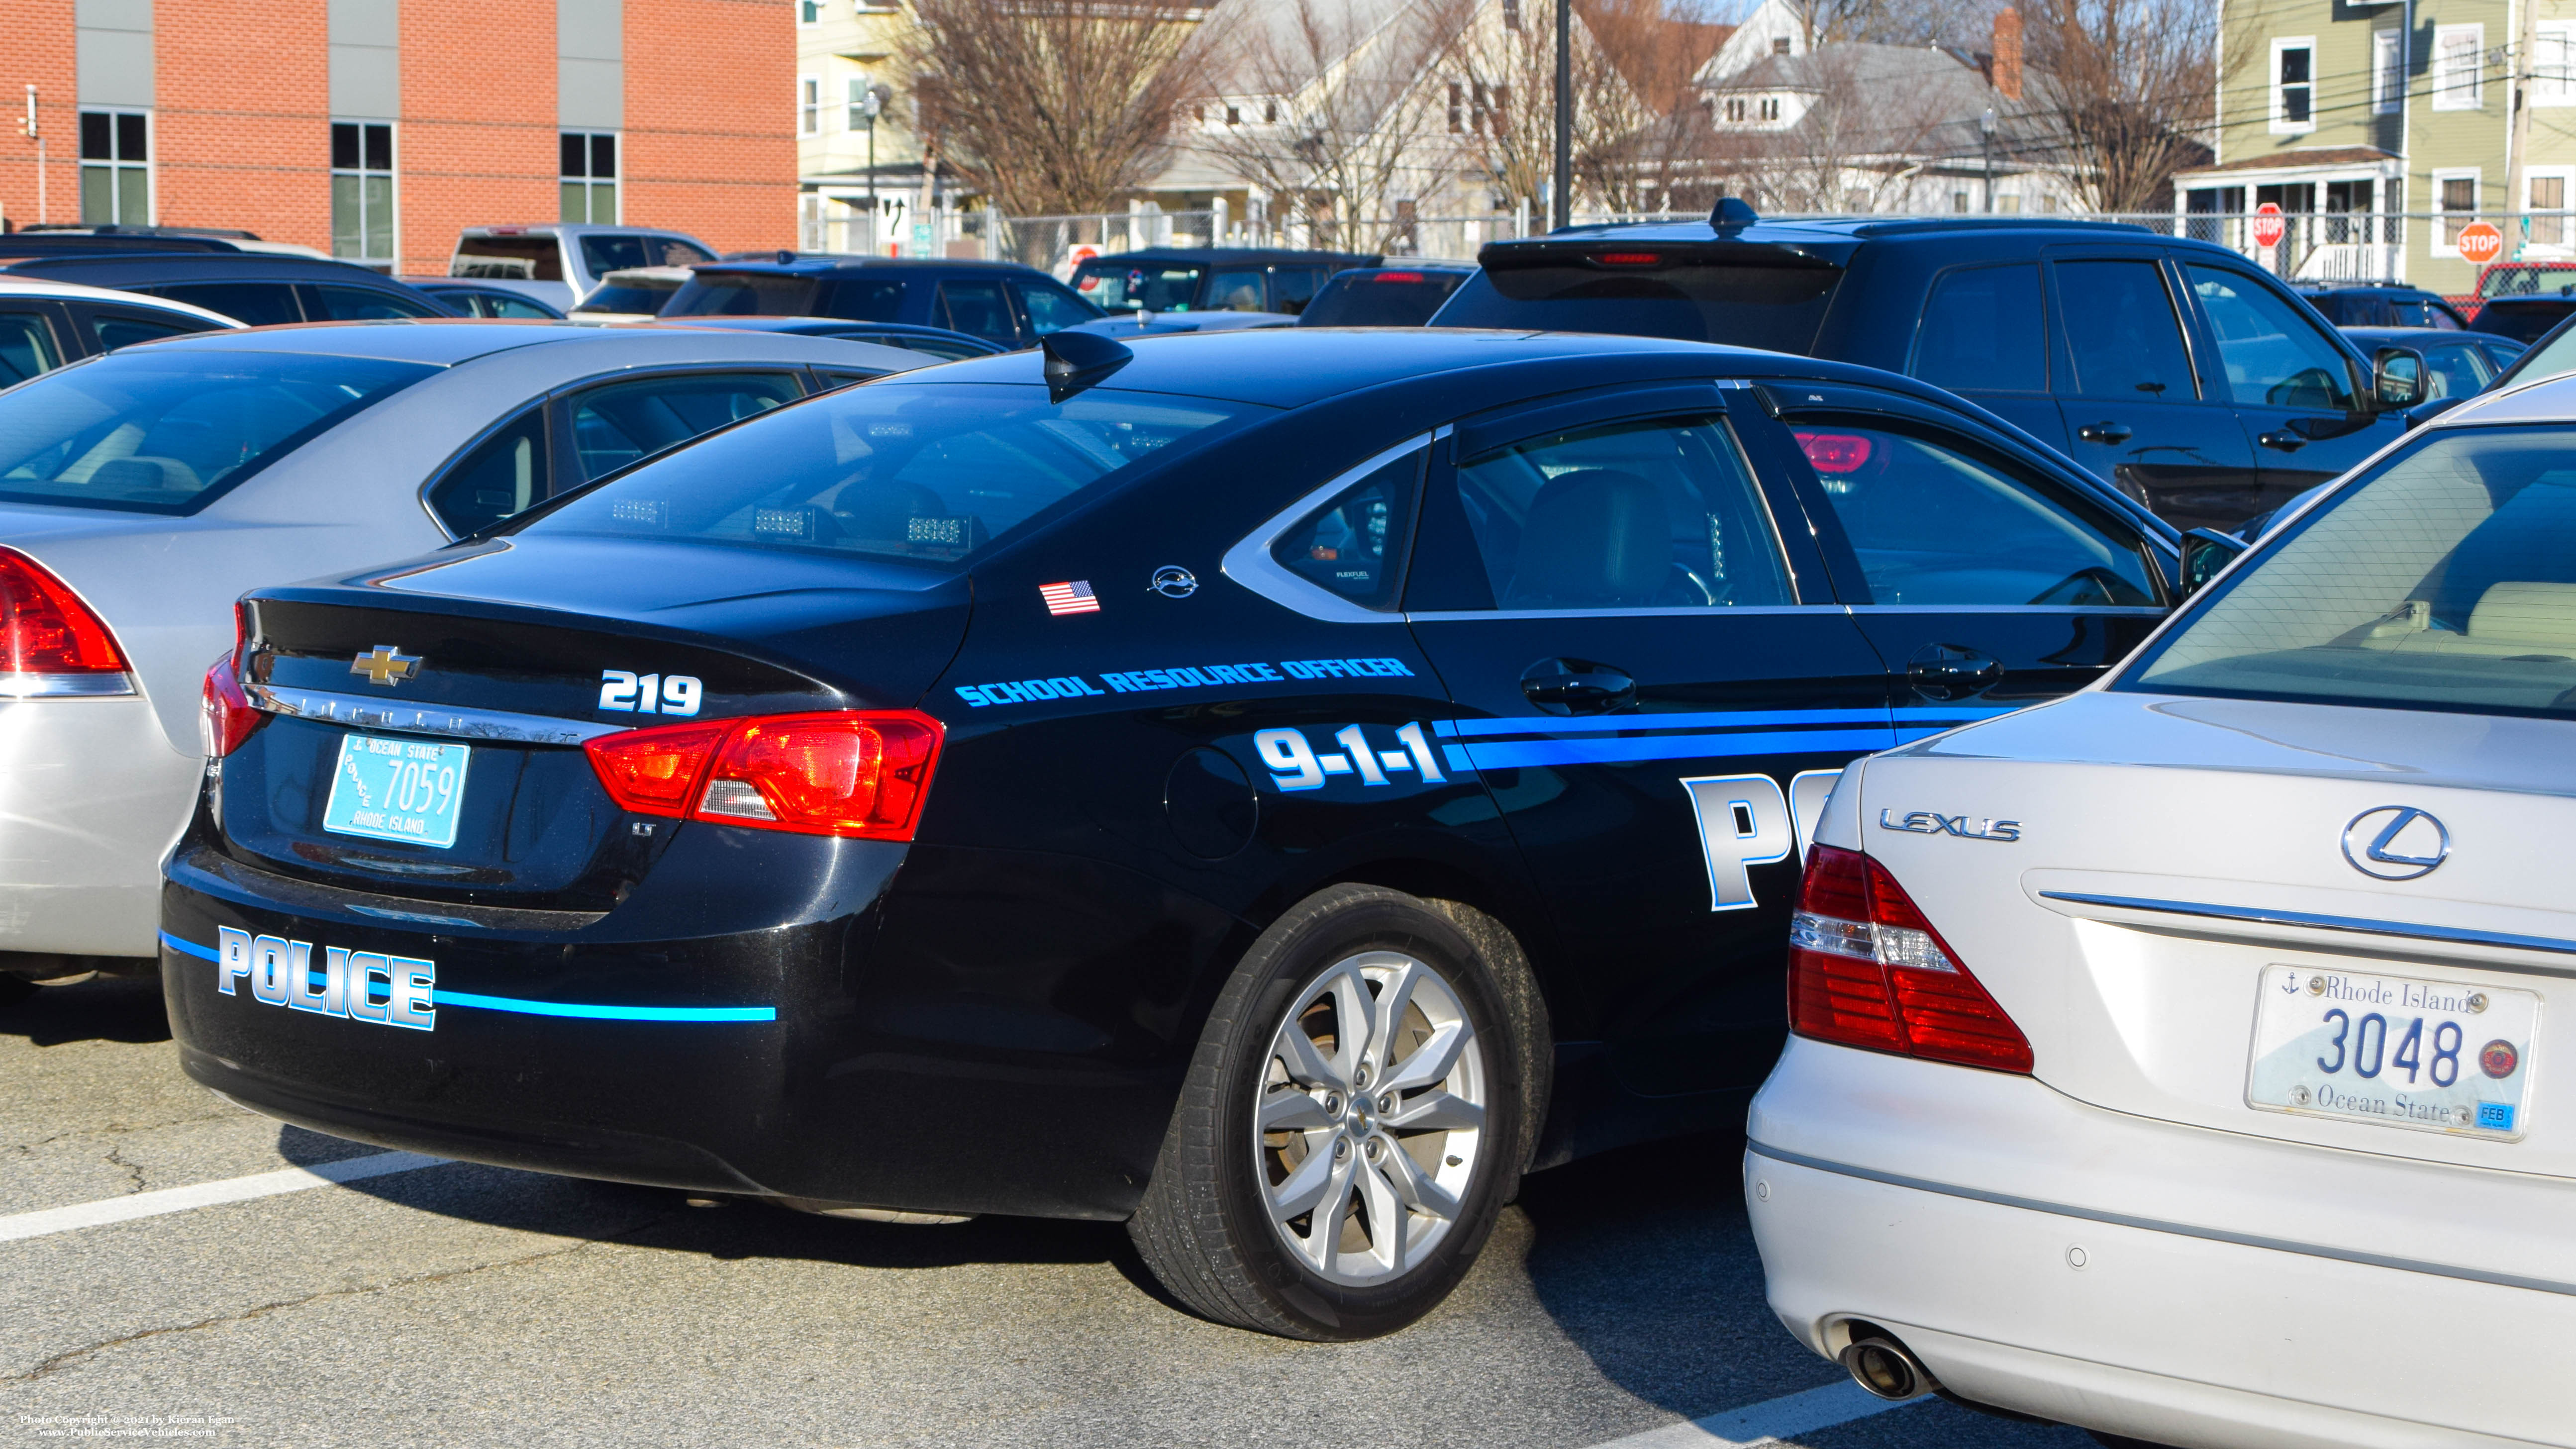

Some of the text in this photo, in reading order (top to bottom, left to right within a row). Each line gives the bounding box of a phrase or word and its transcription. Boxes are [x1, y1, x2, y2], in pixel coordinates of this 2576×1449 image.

[2254, 217, 2281, 236] STOP
[2461, 235, 2498, 252] STOP
[598, 669, 702, 716] 219
[955, 658, 1415, 707] SCHOOL RESOURCE OFFICER
[370, 739, 438, 762] OCEAN STATE
[1253, 721, 1447, 792] 9-1-1
[344, 754, 372, 808] POLICE
[383, 759, 455, 815] 7059
[353, 810, 424, 835] RHODE ISLAND
[632, 822, 656, 836] LT
[1880, 808, 2022, 842] LEXUS
[218, 925, 436, 1032] POLICE
[2324, 975, 2471, 1013] Rhode Island
[2317, 1008, 2463, 1088] 3048
[2318, 1084, 2450, 1122] Ocean State
[2480, 1107, 2504, 1121] FEB
